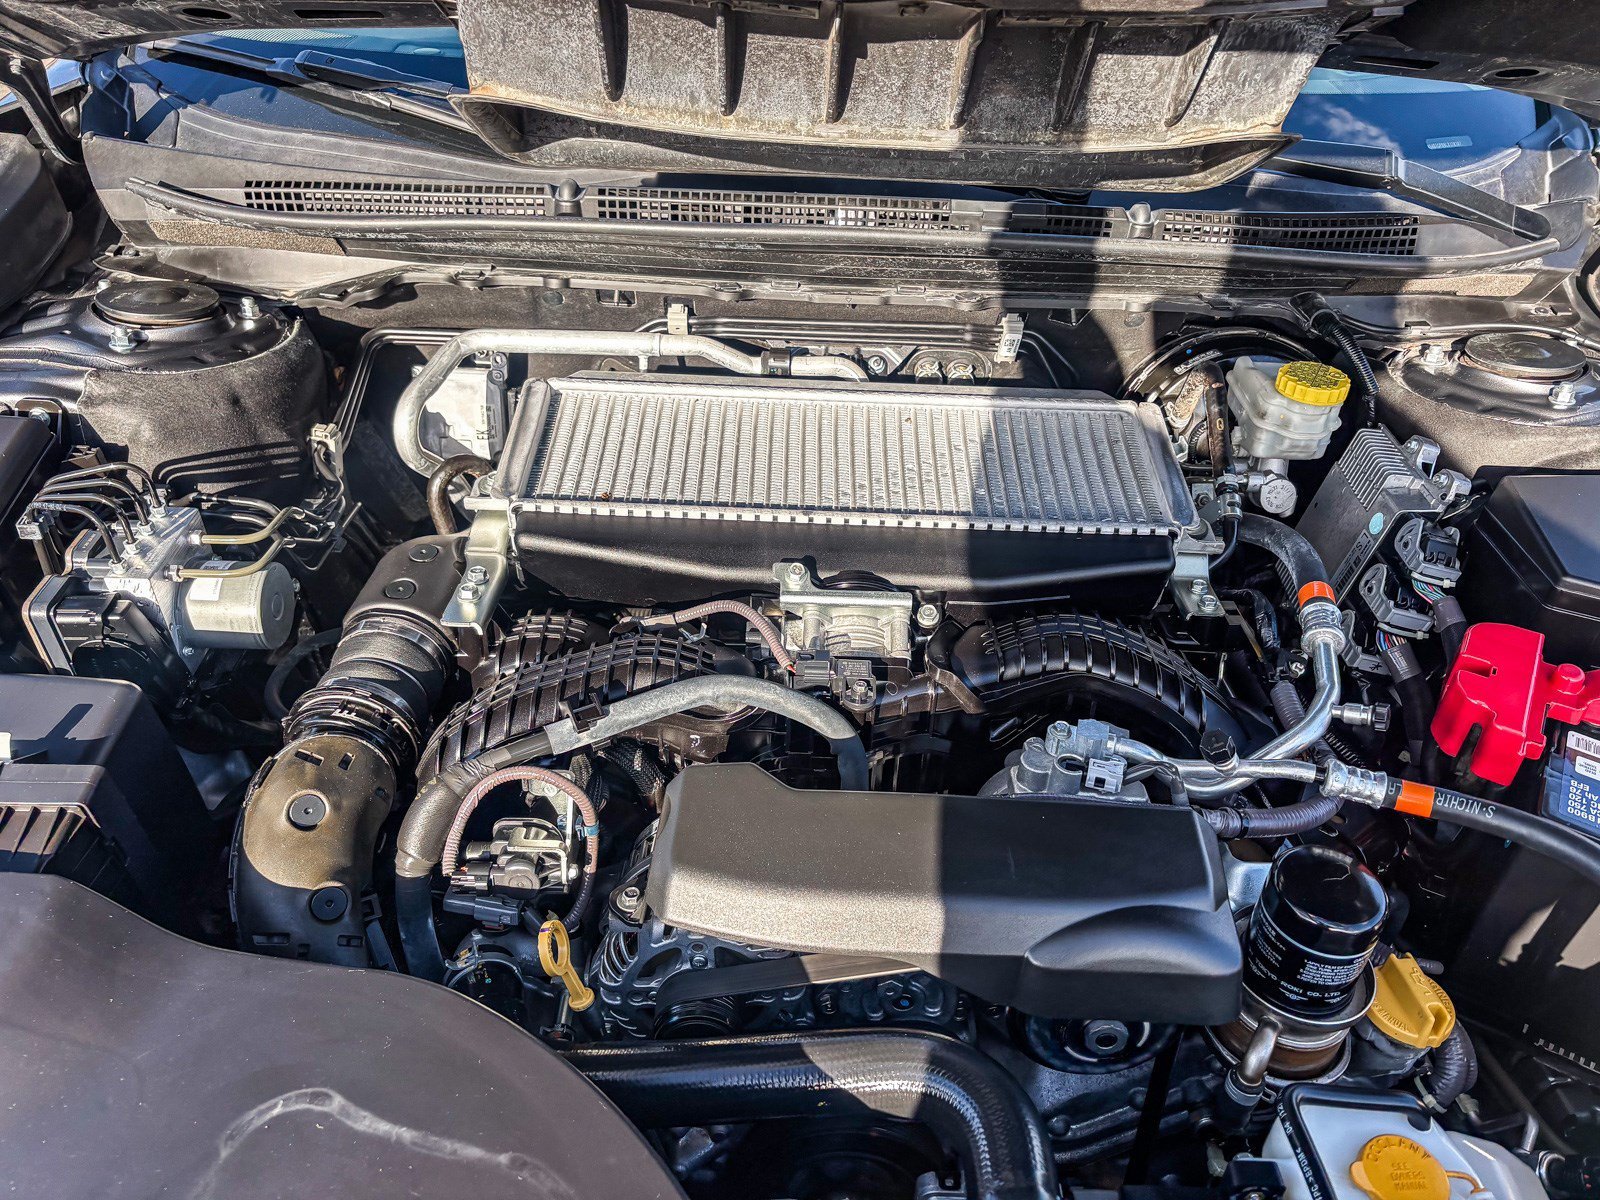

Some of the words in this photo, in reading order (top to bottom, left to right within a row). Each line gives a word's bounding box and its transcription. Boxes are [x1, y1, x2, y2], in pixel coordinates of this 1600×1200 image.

[1569, 786, 1582, 796] 76
[1570, 780, 1590, 792] EFB
[1568, 793, 1588, 805] 120
[1585, 791, 1599, 802] Ah
[1568, 800, 1588, 812] 750
[1567, 806, 1596, 823] B900
[1255, 957, 1278, 980] TOKYO
[1280, 980, 1303, 994] ROKI
[1366, 1137, 1432, 1162] COOLANT
[1391, 1162, 1410, 1171] SEE
